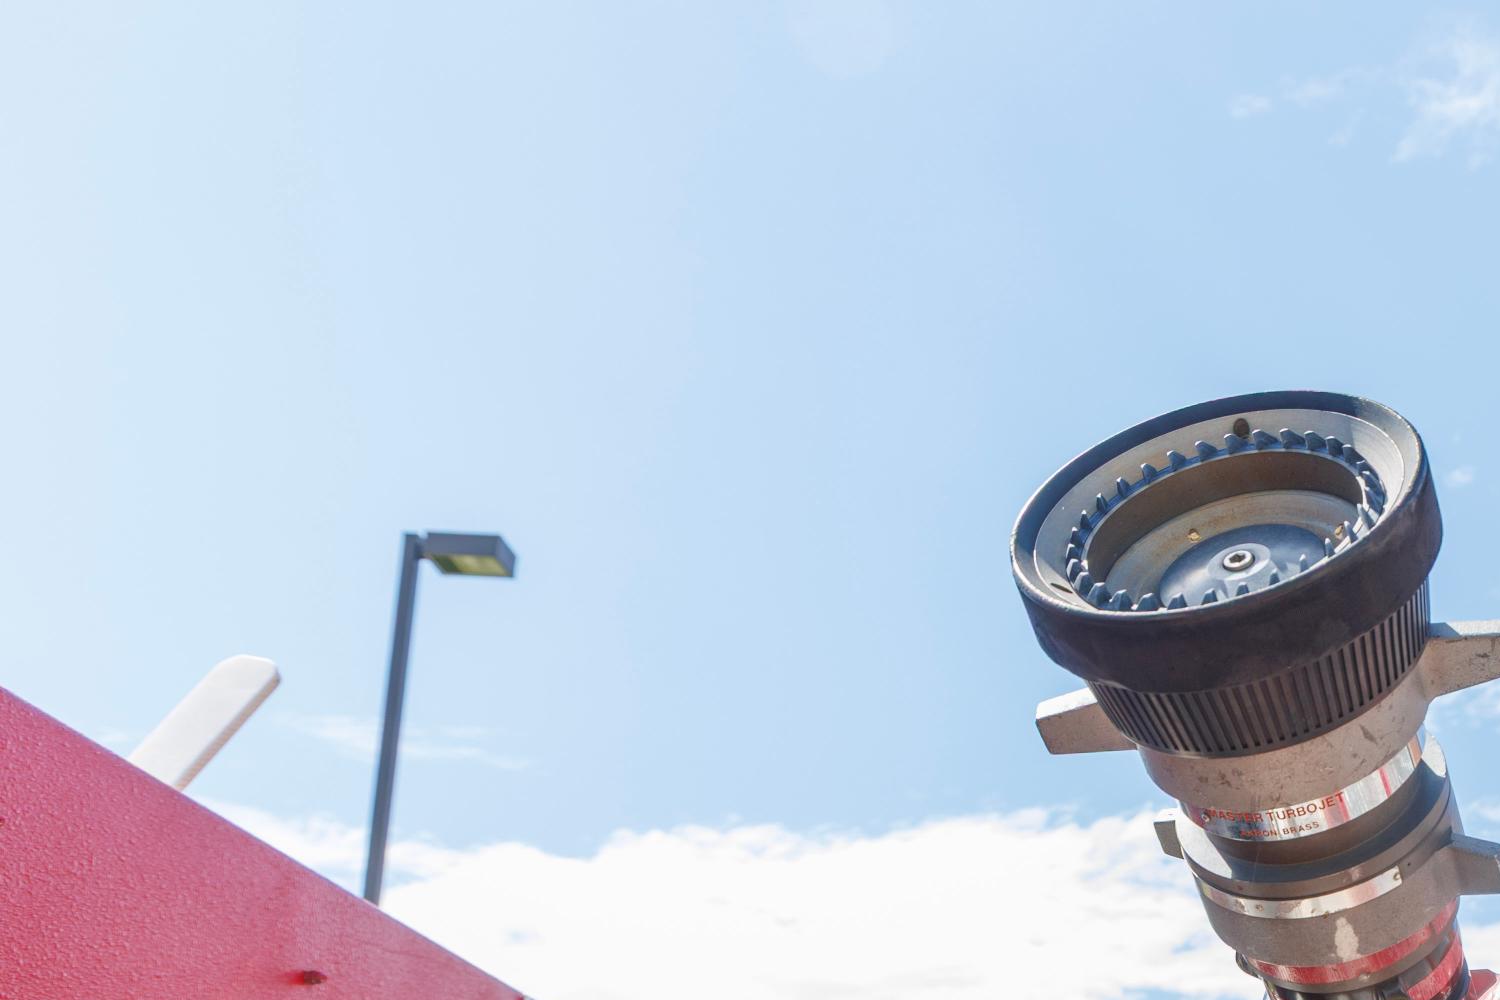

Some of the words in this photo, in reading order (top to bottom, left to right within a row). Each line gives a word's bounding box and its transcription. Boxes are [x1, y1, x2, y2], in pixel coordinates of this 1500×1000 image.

[1206, 807, 1264, 822] MASTER
[1266, 791, 1345, 822] TURBOJET
[1282, 821, 1321, 836] BRASS
